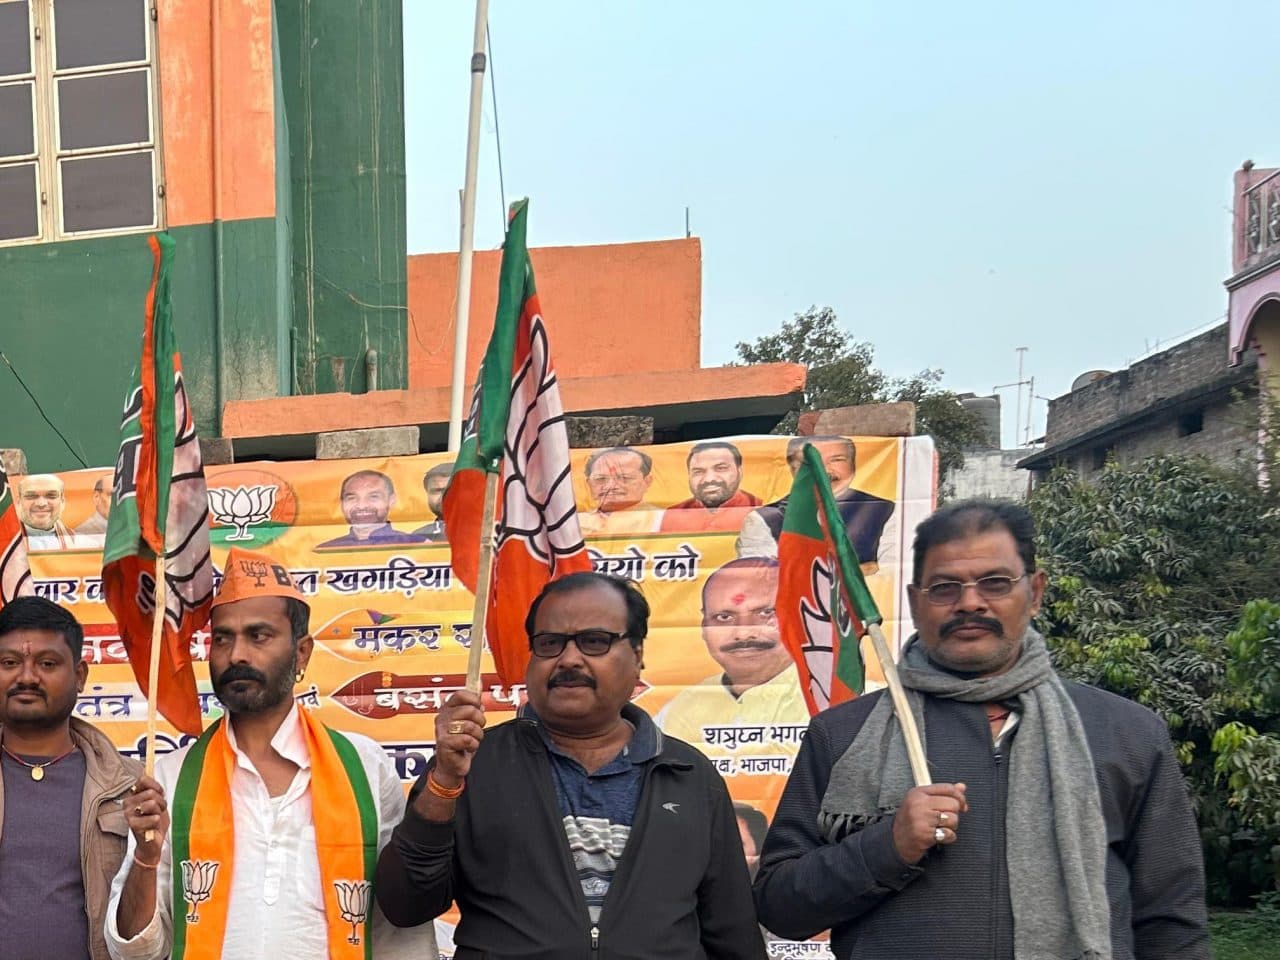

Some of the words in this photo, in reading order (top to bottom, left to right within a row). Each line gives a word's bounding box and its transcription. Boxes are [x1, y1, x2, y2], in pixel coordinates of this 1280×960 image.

[326, 557, 452, 596] खगड़िया
[654, 545, 699, 579] को
[353, 625, 441, 655] मकर
[76, 685, 133, 718] तंत्र
